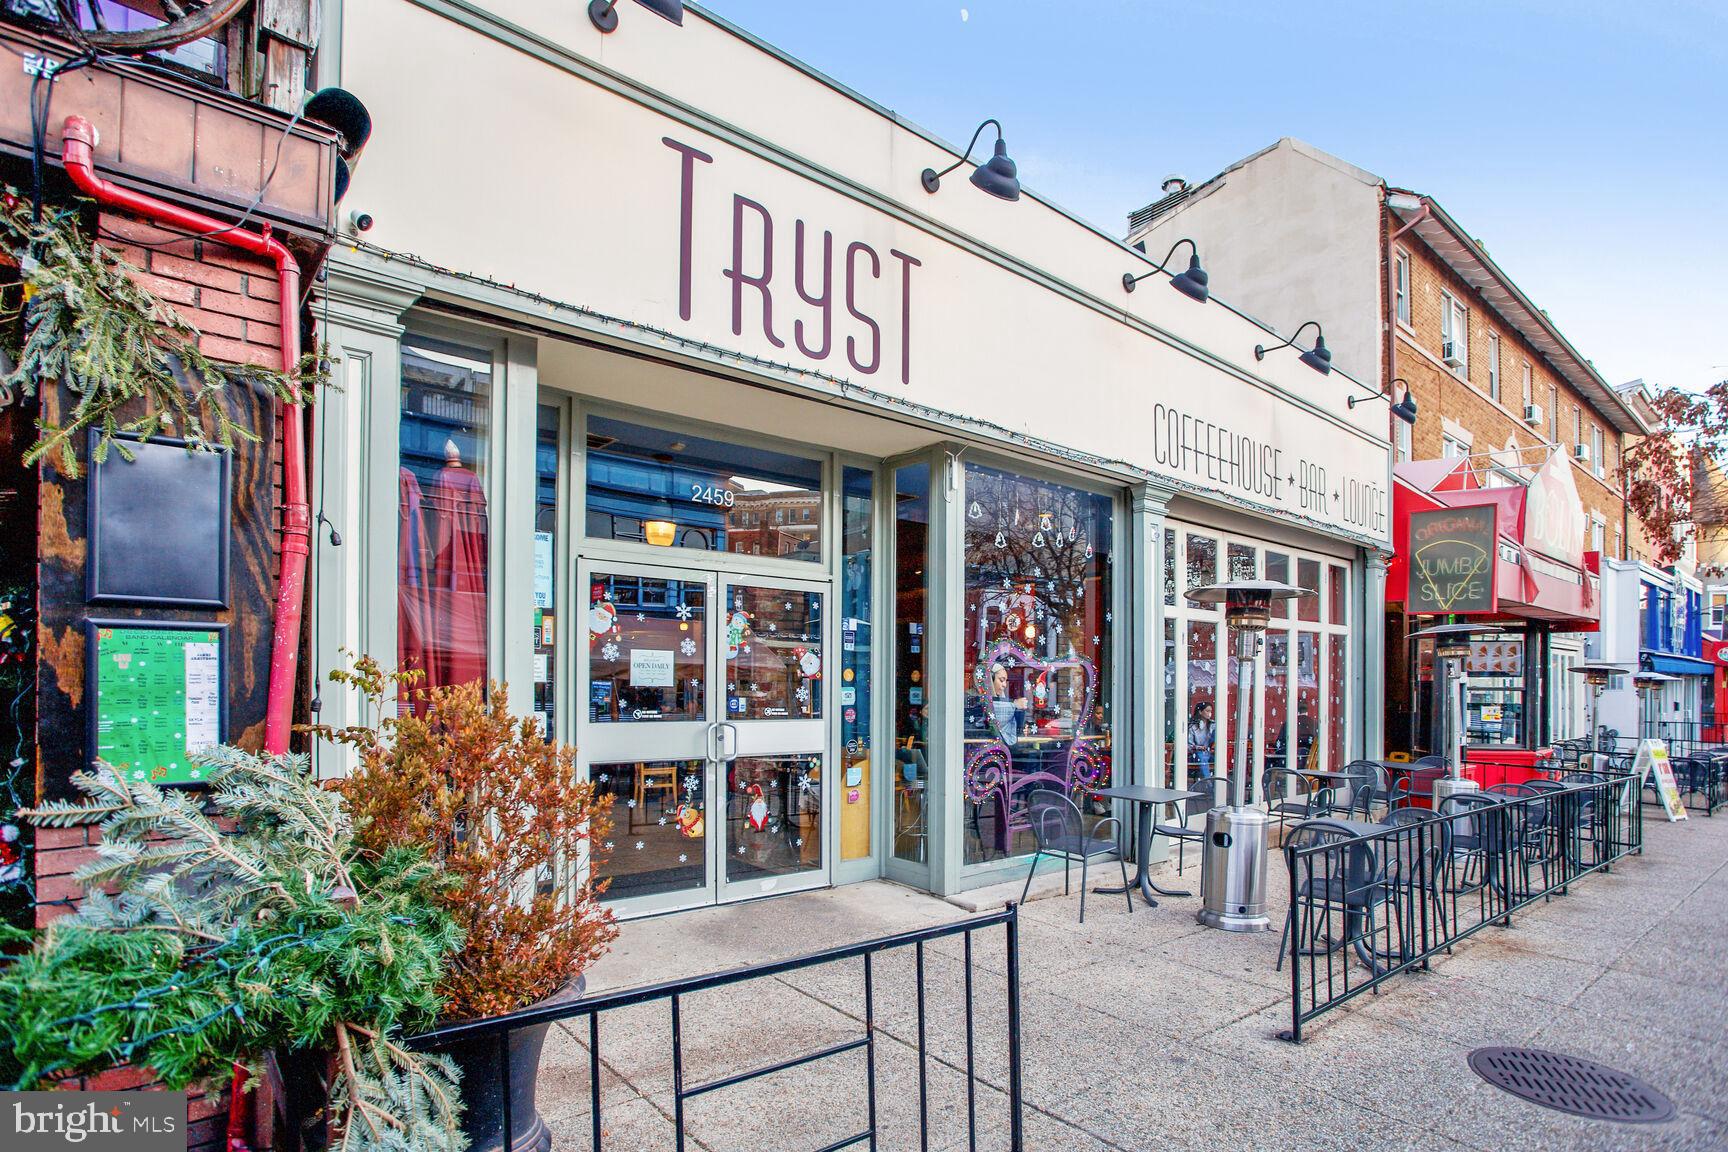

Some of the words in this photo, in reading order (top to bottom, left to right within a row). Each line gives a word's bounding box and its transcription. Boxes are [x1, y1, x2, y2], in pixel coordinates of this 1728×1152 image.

[661, 136, 922, 385] TRYST
[1154, 403, 1282, 501] COFFEEHOUSE
[1299, 459, 1328, 516] BAR
[1343, 475, 1386, 534] LOUNGE
[691, 484, 735, 507] 2459
[1416, 556, 1488, 579] JUMBO
[1421, 581, 1482, 601] SLICE
